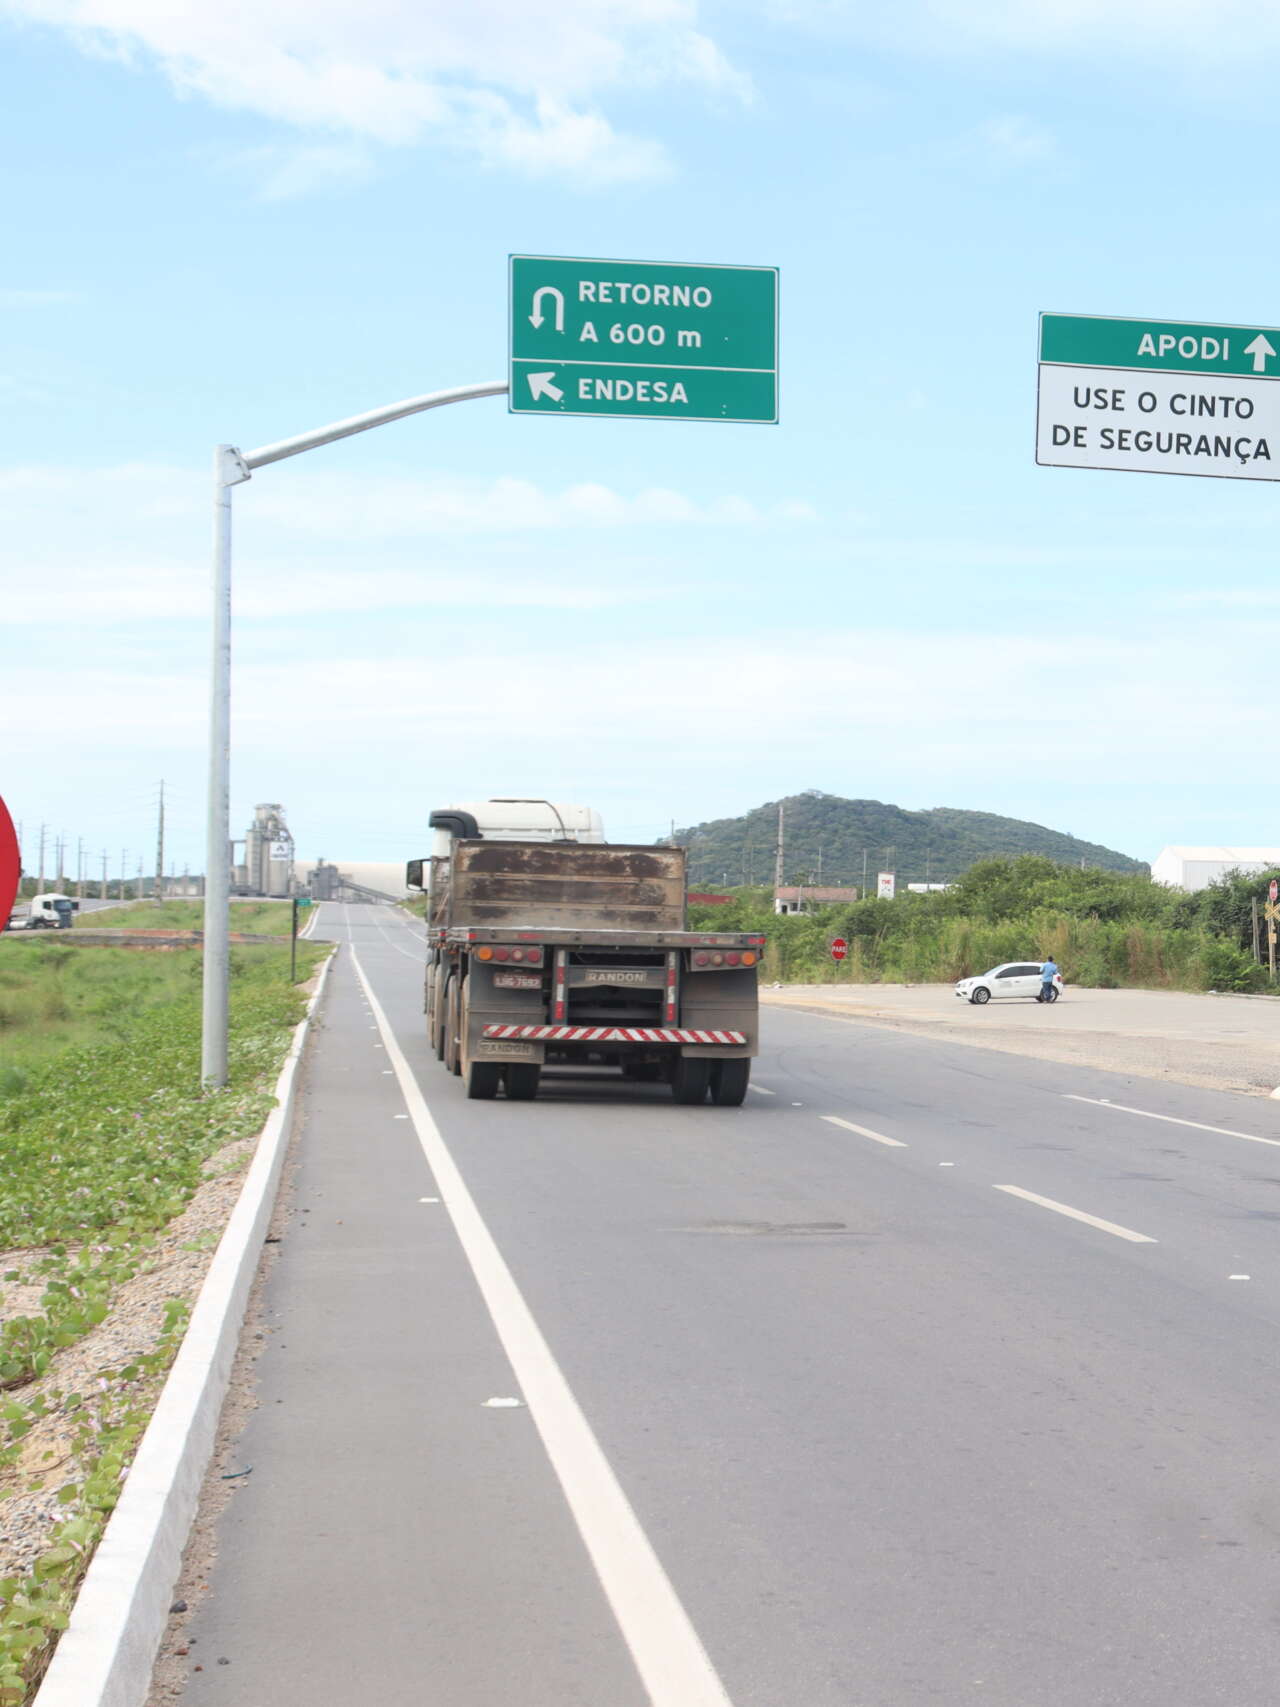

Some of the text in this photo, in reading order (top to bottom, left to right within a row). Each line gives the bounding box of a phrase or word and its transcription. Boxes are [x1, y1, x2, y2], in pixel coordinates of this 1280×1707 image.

[578, 280, 712, 307] RETORNO
[579, 321, 702, 348] A 600 m
[1136, 333, 1229, 361] APODI
[578, 378, 689, 404] ENDESA
[1073, 386, 1254, 419] USE O CINTO
[1052, 424, 1271, 464] DE SEGURANÇA
[589, 971, 644, 982] RANDON
